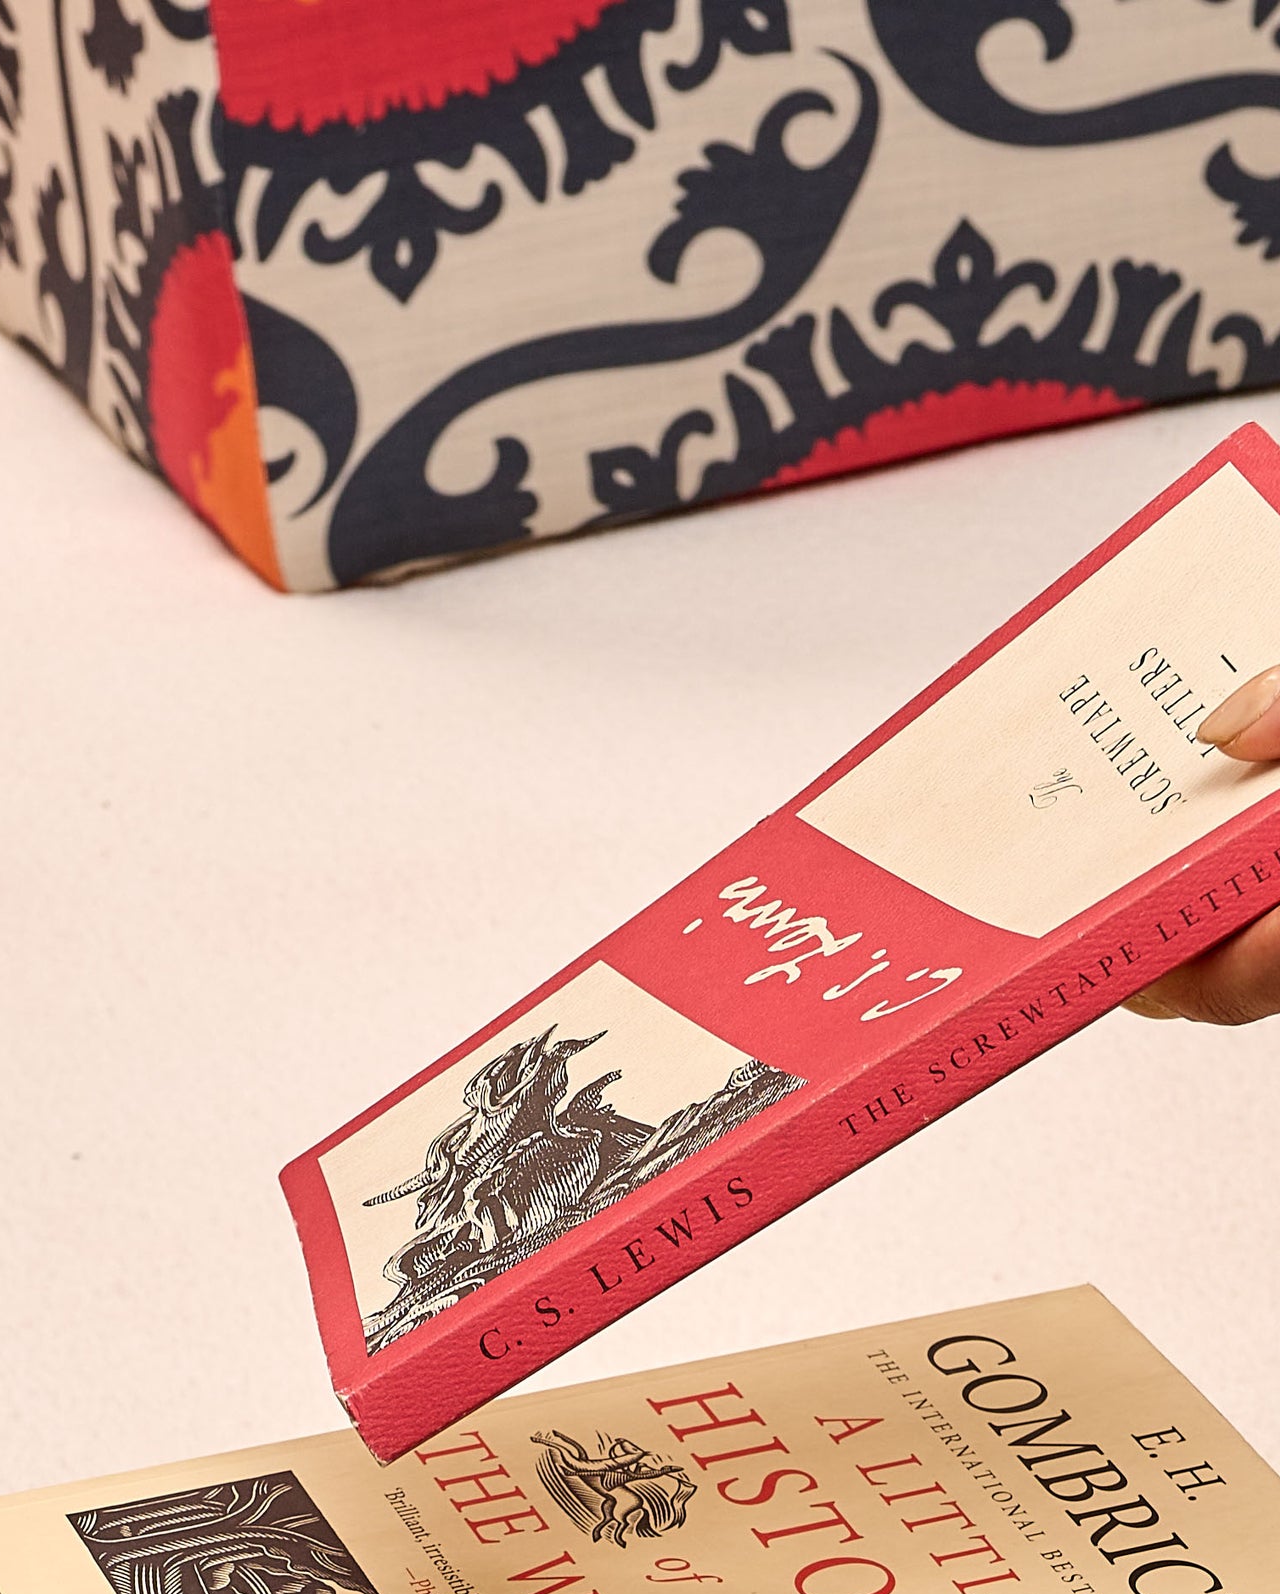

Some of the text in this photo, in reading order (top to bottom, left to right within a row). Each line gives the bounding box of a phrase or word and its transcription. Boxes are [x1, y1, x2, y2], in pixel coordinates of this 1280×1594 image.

[1059, 674, 1182, 815] SCREWTAPE
[1129, 647, 1218, 758] TTERS
[1029, 767, 1083, 809] The
[839, 1082, 916, 1138] THE
[927, 940, 1142, 1085] SCREWTAPE
[479, 1176, 754, 1361] C. S. LEWIS
[814, 1415, 886, 1445] A
[866, 1349, 910, 1386] THE
[902, 1390, 1046, 1543] INTERNATIONAL
[1131, 1425, 1228, 1502] E. H.
[414, 1430, 551, 1544] THE
[645, 1557, 724, 1584] of
